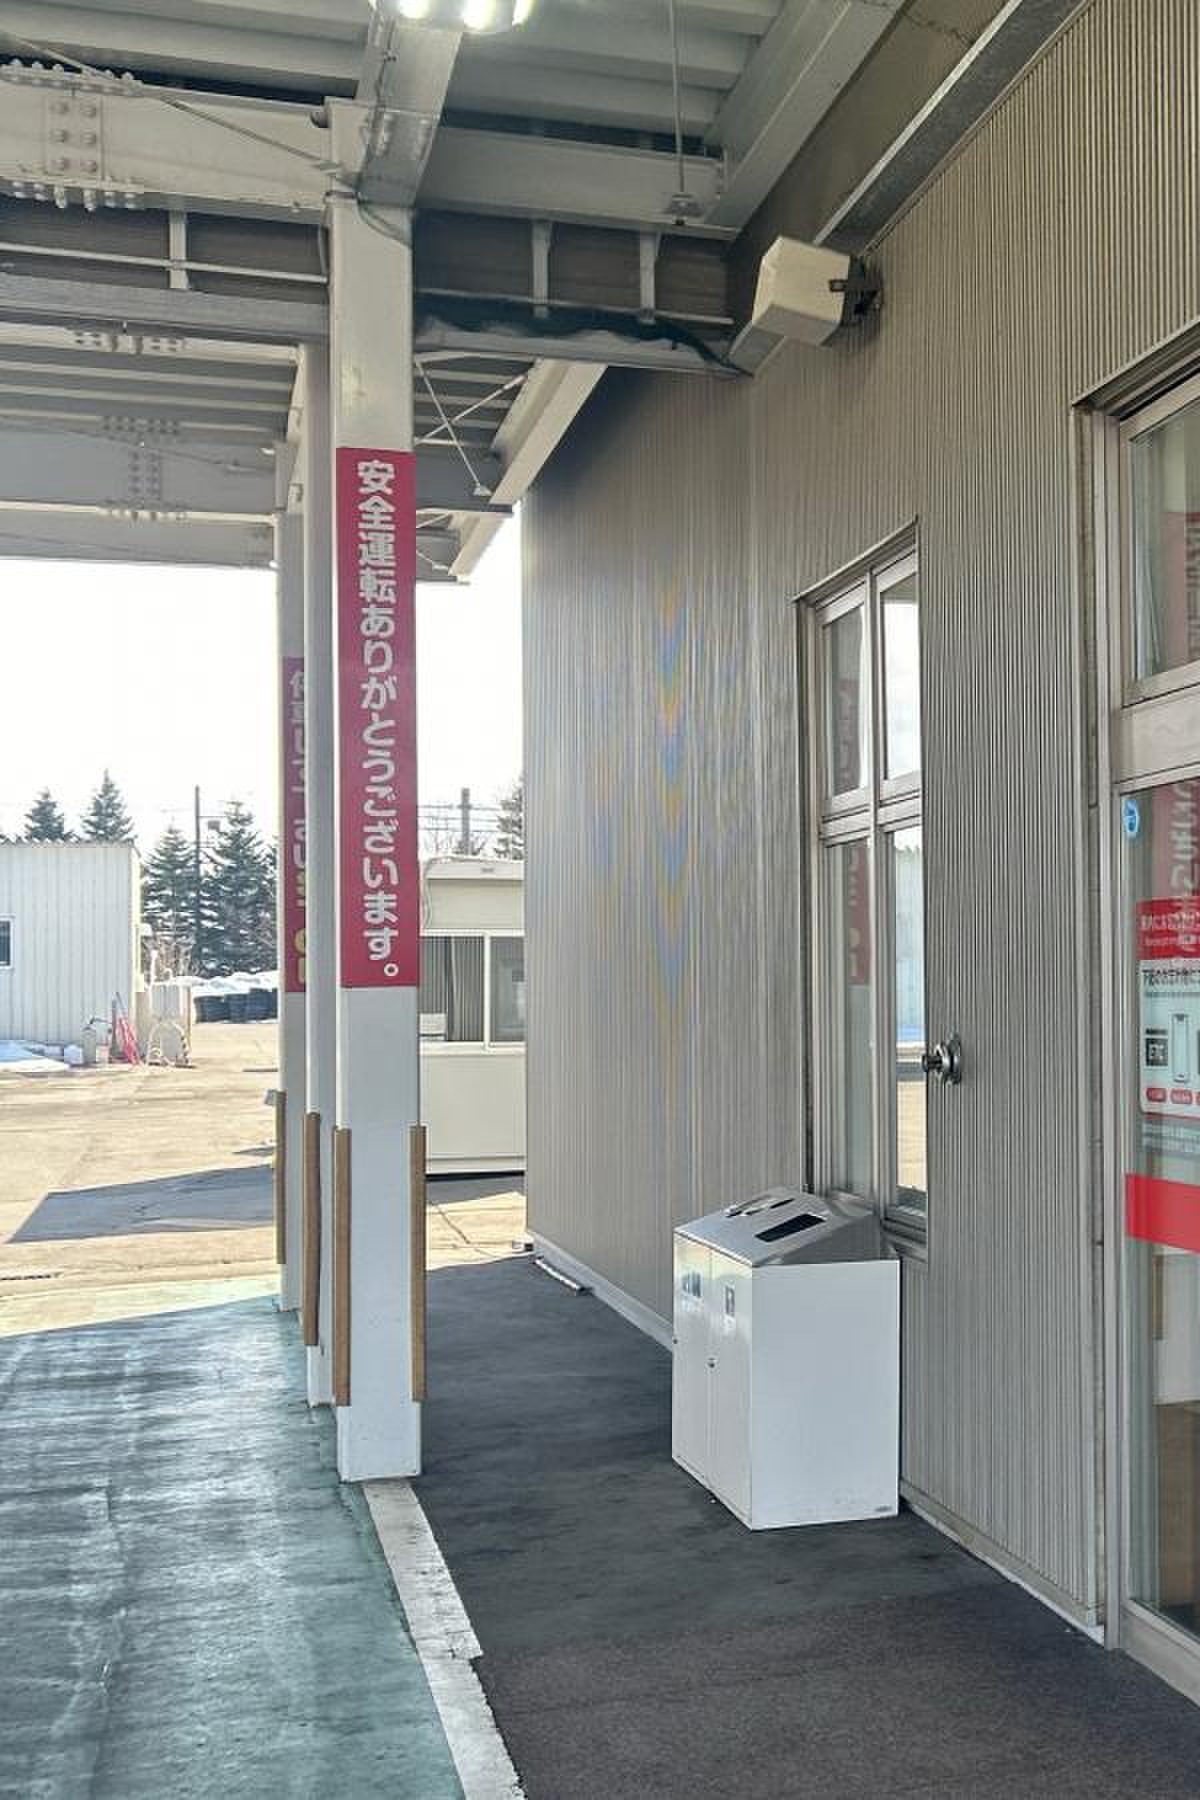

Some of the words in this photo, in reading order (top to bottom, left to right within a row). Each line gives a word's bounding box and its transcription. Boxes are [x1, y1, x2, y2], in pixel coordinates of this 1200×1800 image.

[357, 459, 399, 977] 安全運転ありがとうございます。
